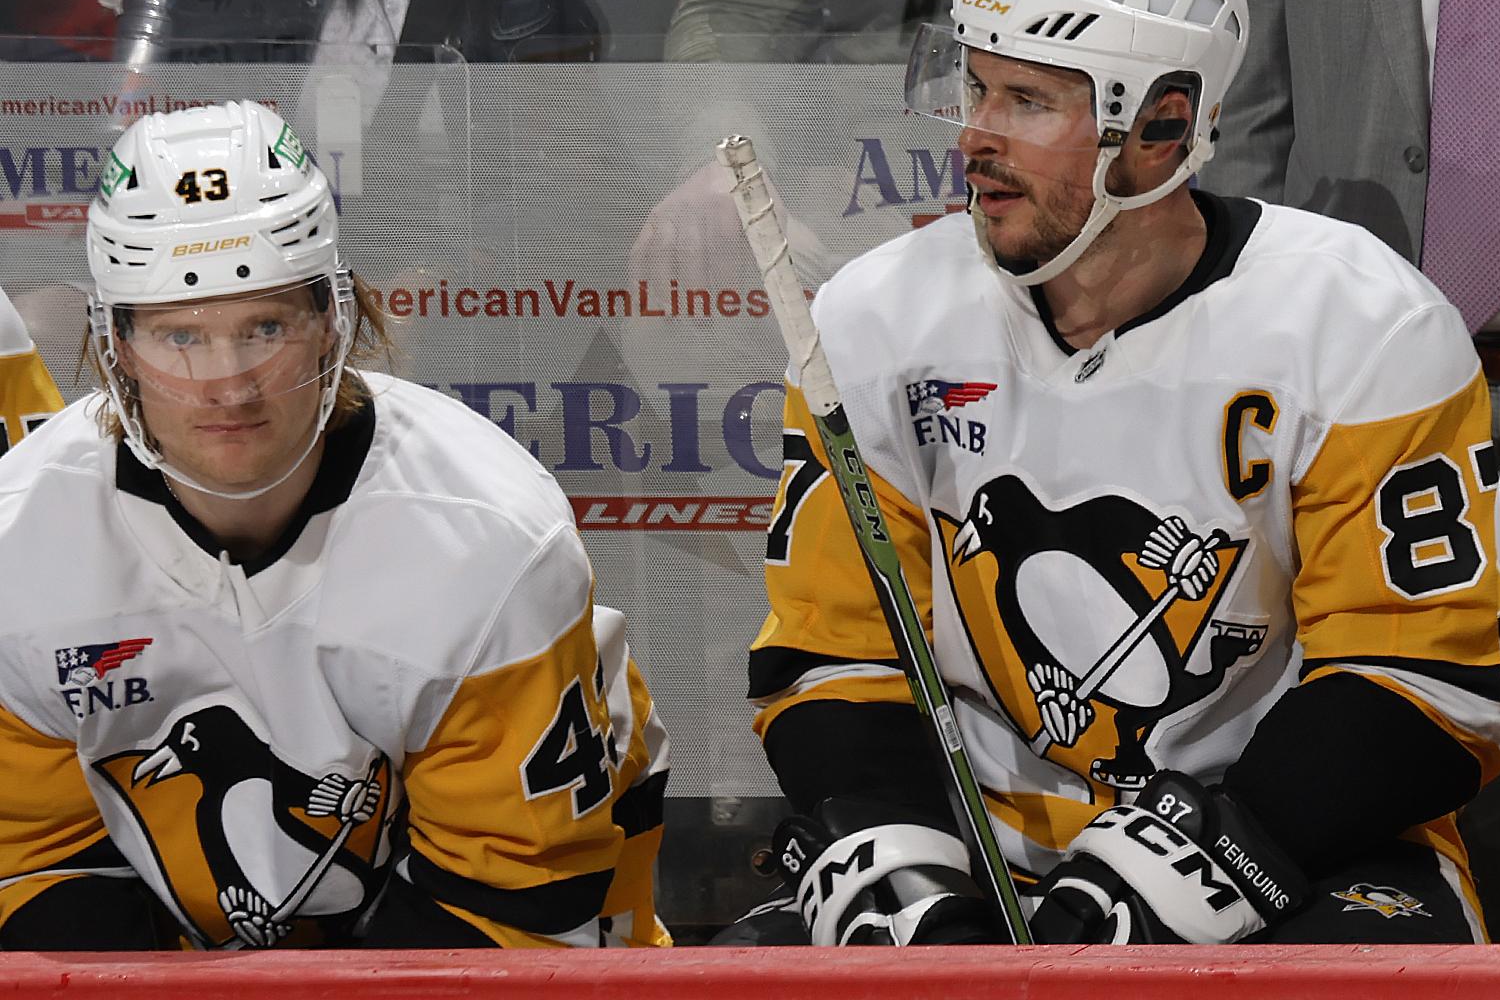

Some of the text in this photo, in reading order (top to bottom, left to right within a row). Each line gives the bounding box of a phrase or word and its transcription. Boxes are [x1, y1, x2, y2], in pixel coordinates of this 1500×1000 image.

[174, 168, 231, 204] 43
[913, 414, 987, 456] F.N.B.
[1222, 389, 1280, 503] C
[842, 447, 889, 543] CCM
[519, 652, 621, 821] 4
[1156, 793, 1193, 824] 87
[782, 837, 807, 873] 87
[1084, 806, 1243, 915] CCM
[1214, 834, 1290, 911] PENGUINS
